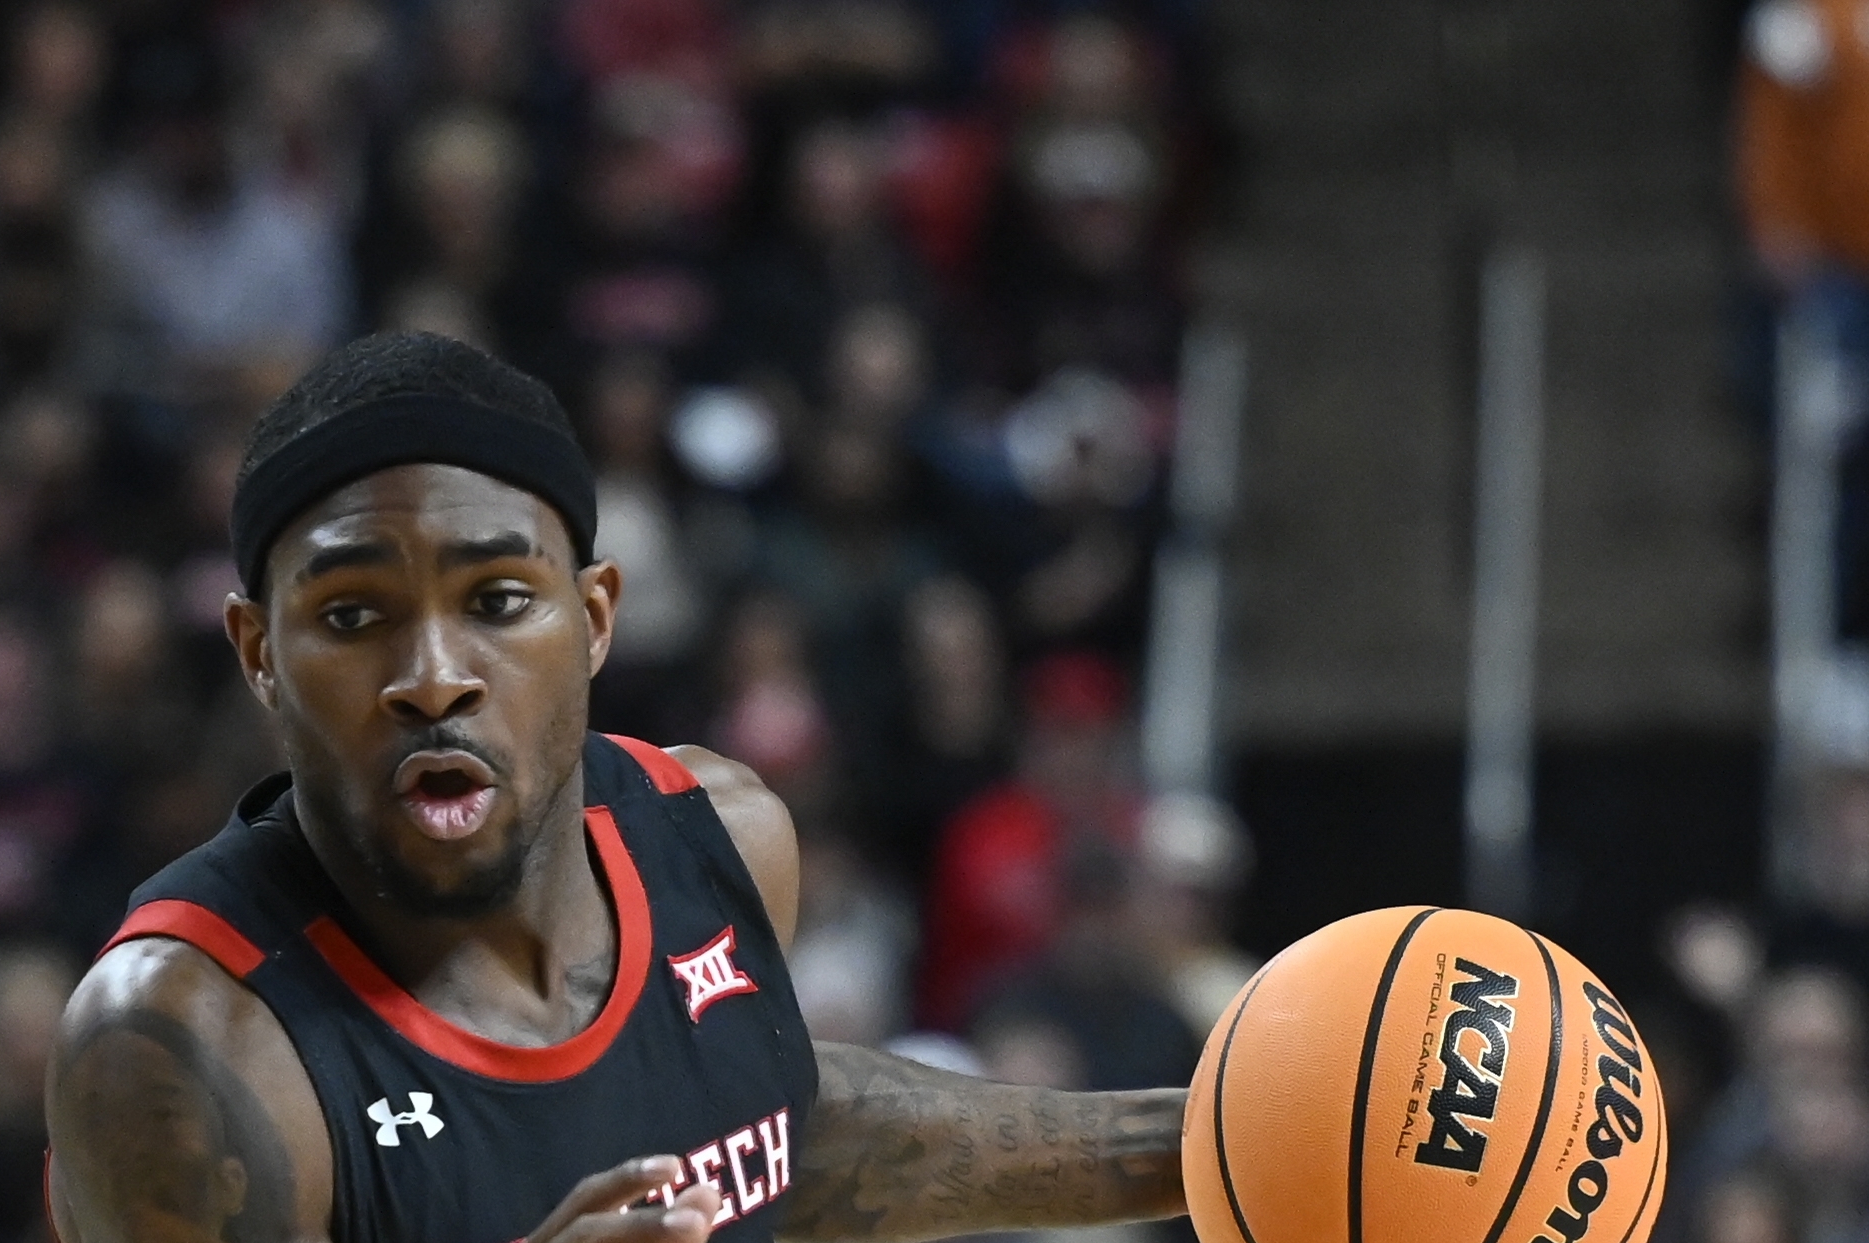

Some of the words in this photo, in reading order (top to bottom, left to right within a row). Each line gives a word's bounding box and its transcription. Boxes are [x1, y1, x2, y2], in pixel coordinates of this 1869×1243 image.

[1425, 953, 1446, 1026] OFFICIAL
[1410, 1032, 1434, 1094] GAME
[1413, 956, 1520, 1174] NCAA
[1395, 1099, 1419, 1158] BALL
[1571, 1091, 1586, 1132] GAME
[1555, 1137, 1575, 1173] BALL
